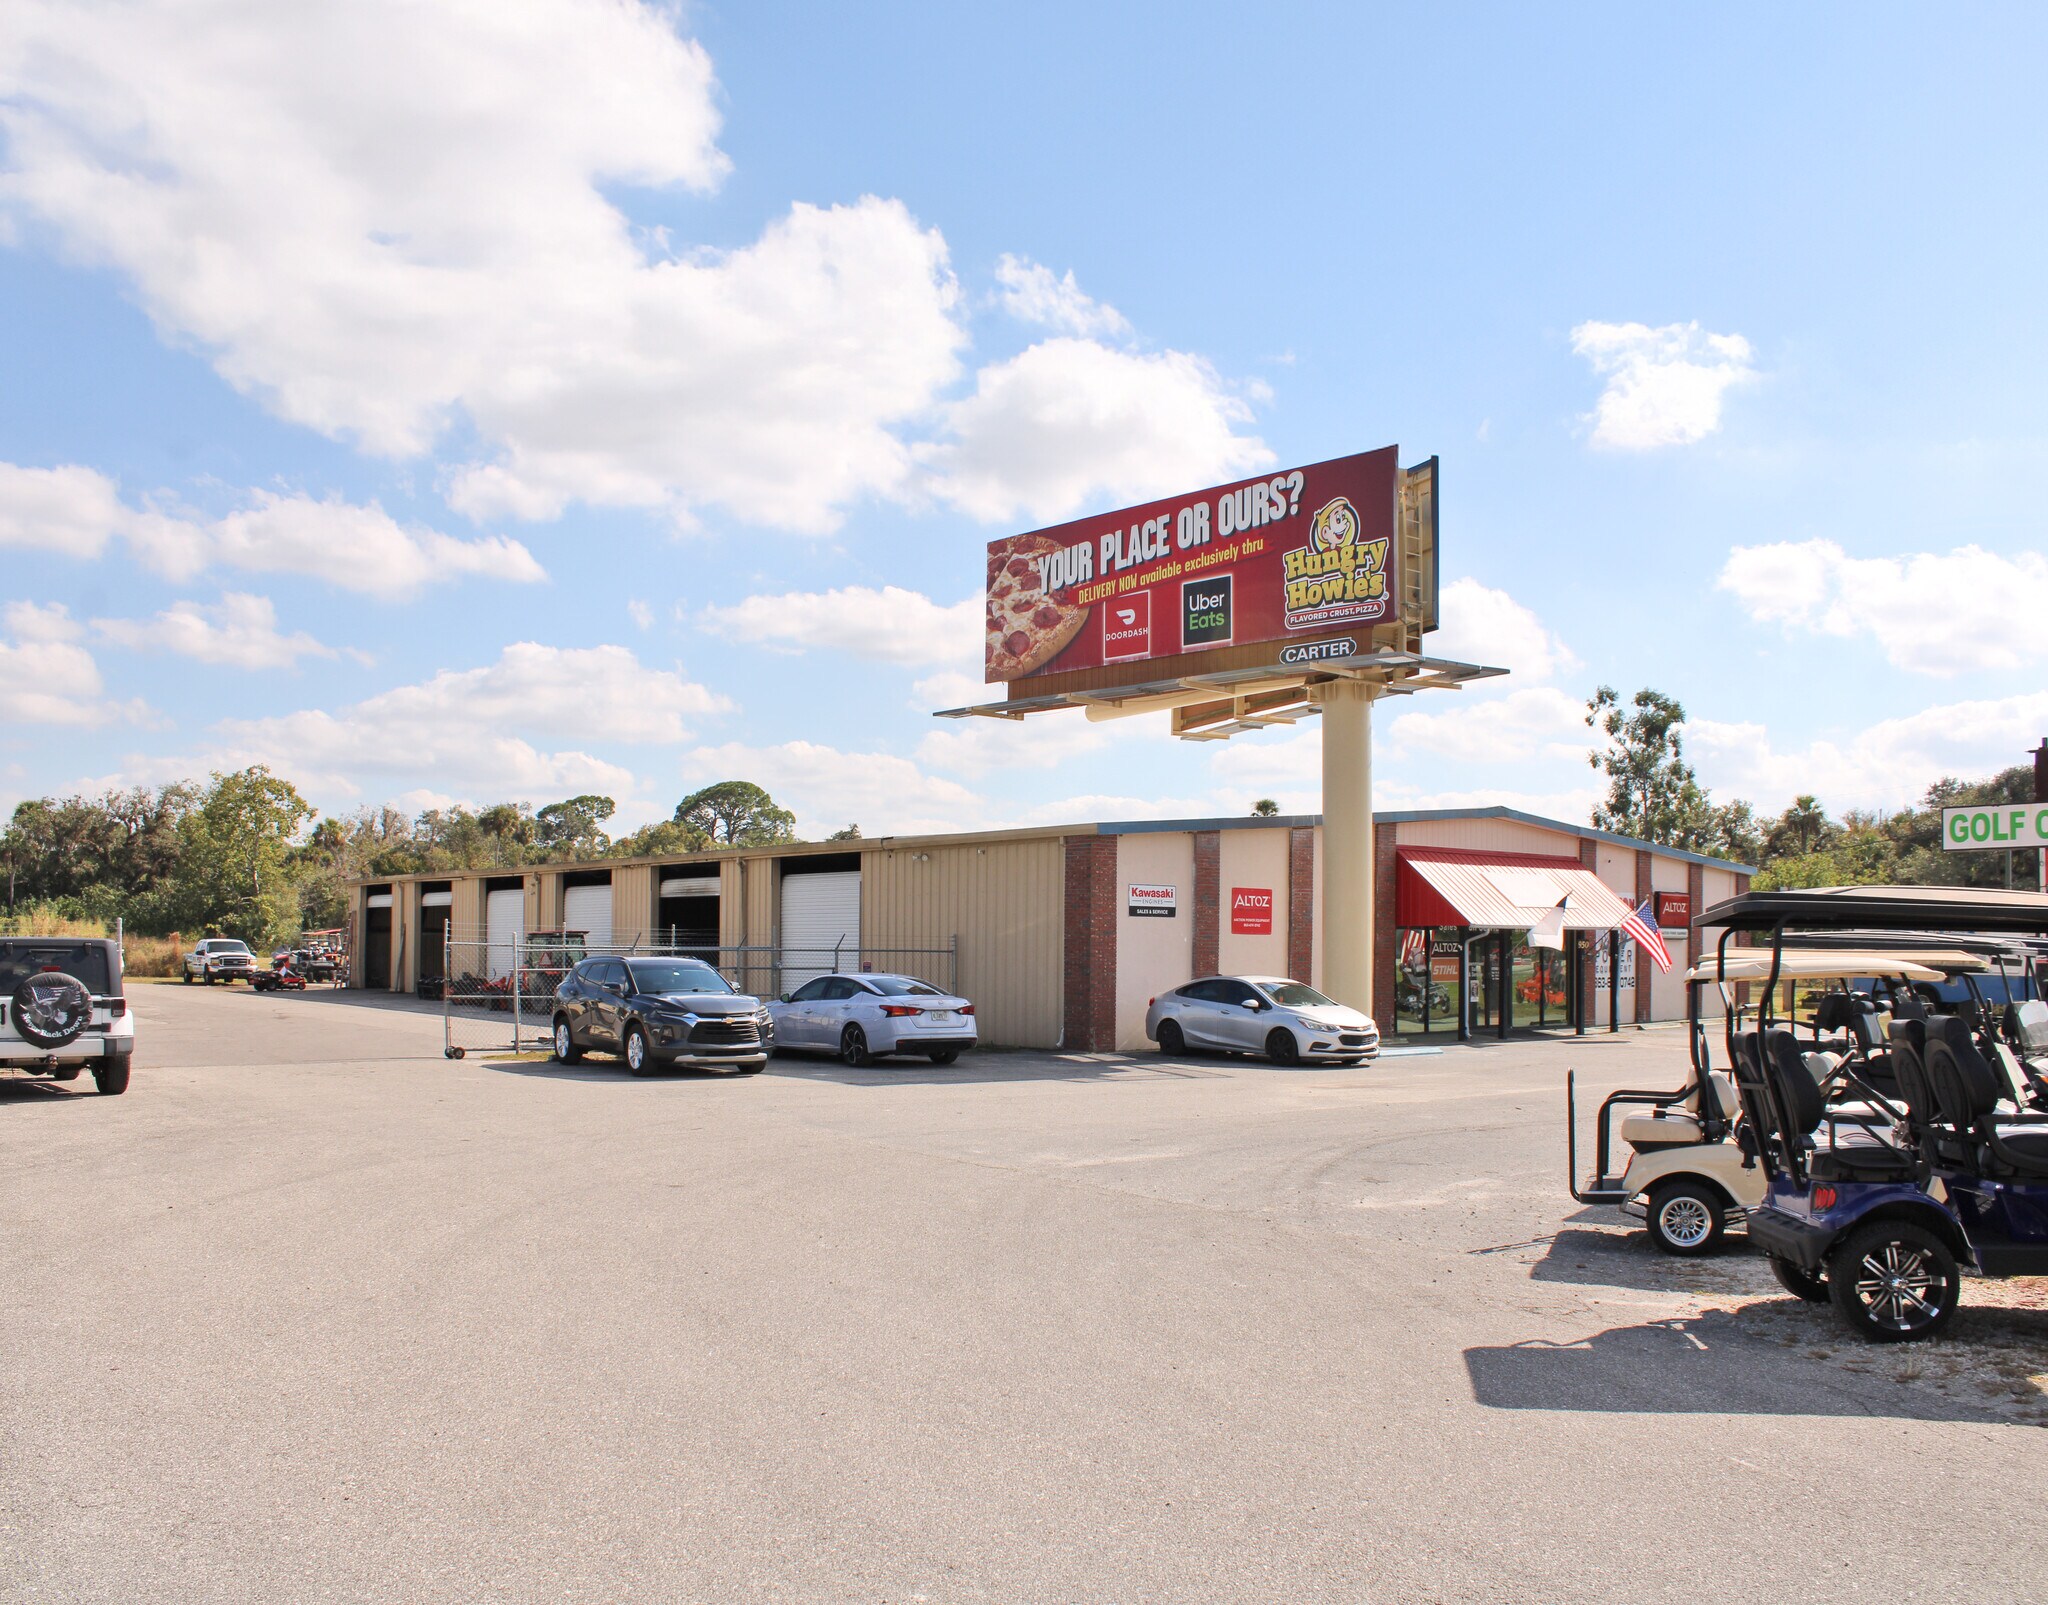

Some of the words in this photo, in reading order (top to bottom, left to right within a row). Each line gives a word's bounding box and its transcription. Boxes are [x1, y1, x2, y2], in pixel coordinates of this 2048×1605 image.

[1037, 541, 1093, 595] YOUR
[1101, 513, 1171, 576] PLACE
[1177, 502, 1210, 549] OR
[1218, 471, 1304, 536] OURS?
[1284, 540, 1387, 580] Hungry
[1078, 579, 1116, 604] DELIVERY
[1119, 573, 1138, 592] NOW
[1140, 561, 1182, 586] available
[1184, 544, 1239, 572] exclusively
[1242, 538, 1264, 555] thru
[1287, 571, 1384, 610] Howie's
[1189, 593, 1225, 612] Uber
[1189, 611, 1225, 630] Eats
[1290, 612, 1328, 624] FLAVORED
[1356, 604, 1379, 614] PIZZA
[1105, 627, 1149, 641] DOORDASH
[1285, 642, 1350, 662] CARTER
[1949, 811, 2025, 843] GOLF
[1131, 888, 1174, 898] Kawasaki
[1234, 894, 1270, 908] ALTOZ
[1662, 902, 1687, 914] ALTOZ
[1432, 943, 1459, 954] ALTOZ
[1433, 965, 1458, 975] STIHL
[40, 1029, 63, 1038] Back
[62, 1016, 83, 1036] Down
